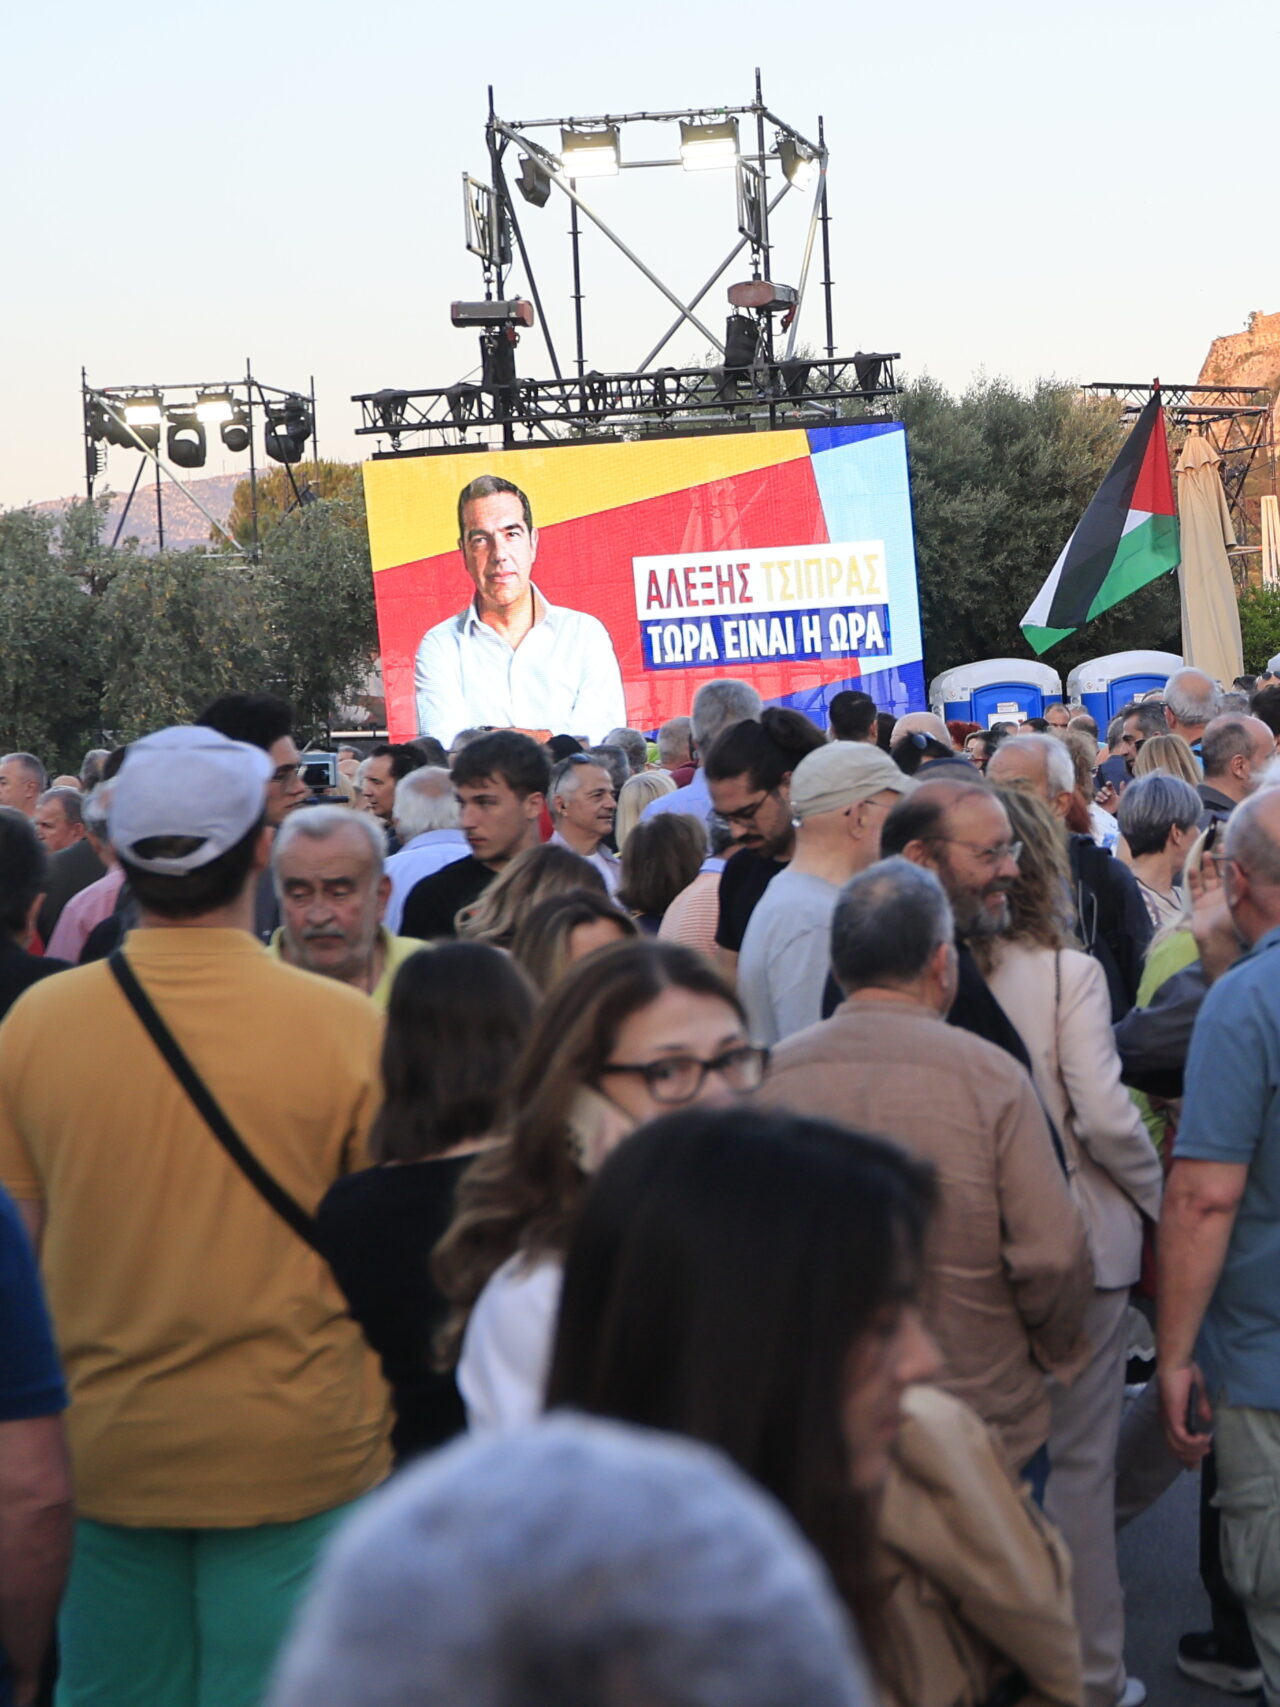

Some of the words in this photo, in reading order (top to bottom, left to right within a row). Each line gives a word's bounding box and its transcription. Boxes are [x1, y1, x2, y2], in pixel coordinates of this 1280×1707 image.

[646, 562, 753, 610] ΑΛΕΞΗΣ
[760, 554, 881, 602] ΤΣΙΠΡΑΣ
[647, 622, 719, 664] ΤΩΡΑ
[723, 616, 796, 659] ΕΙΝΑΙ
[801, 614, 822, 654] Η
[828, 610, 885, 651] ΩΡΑ
